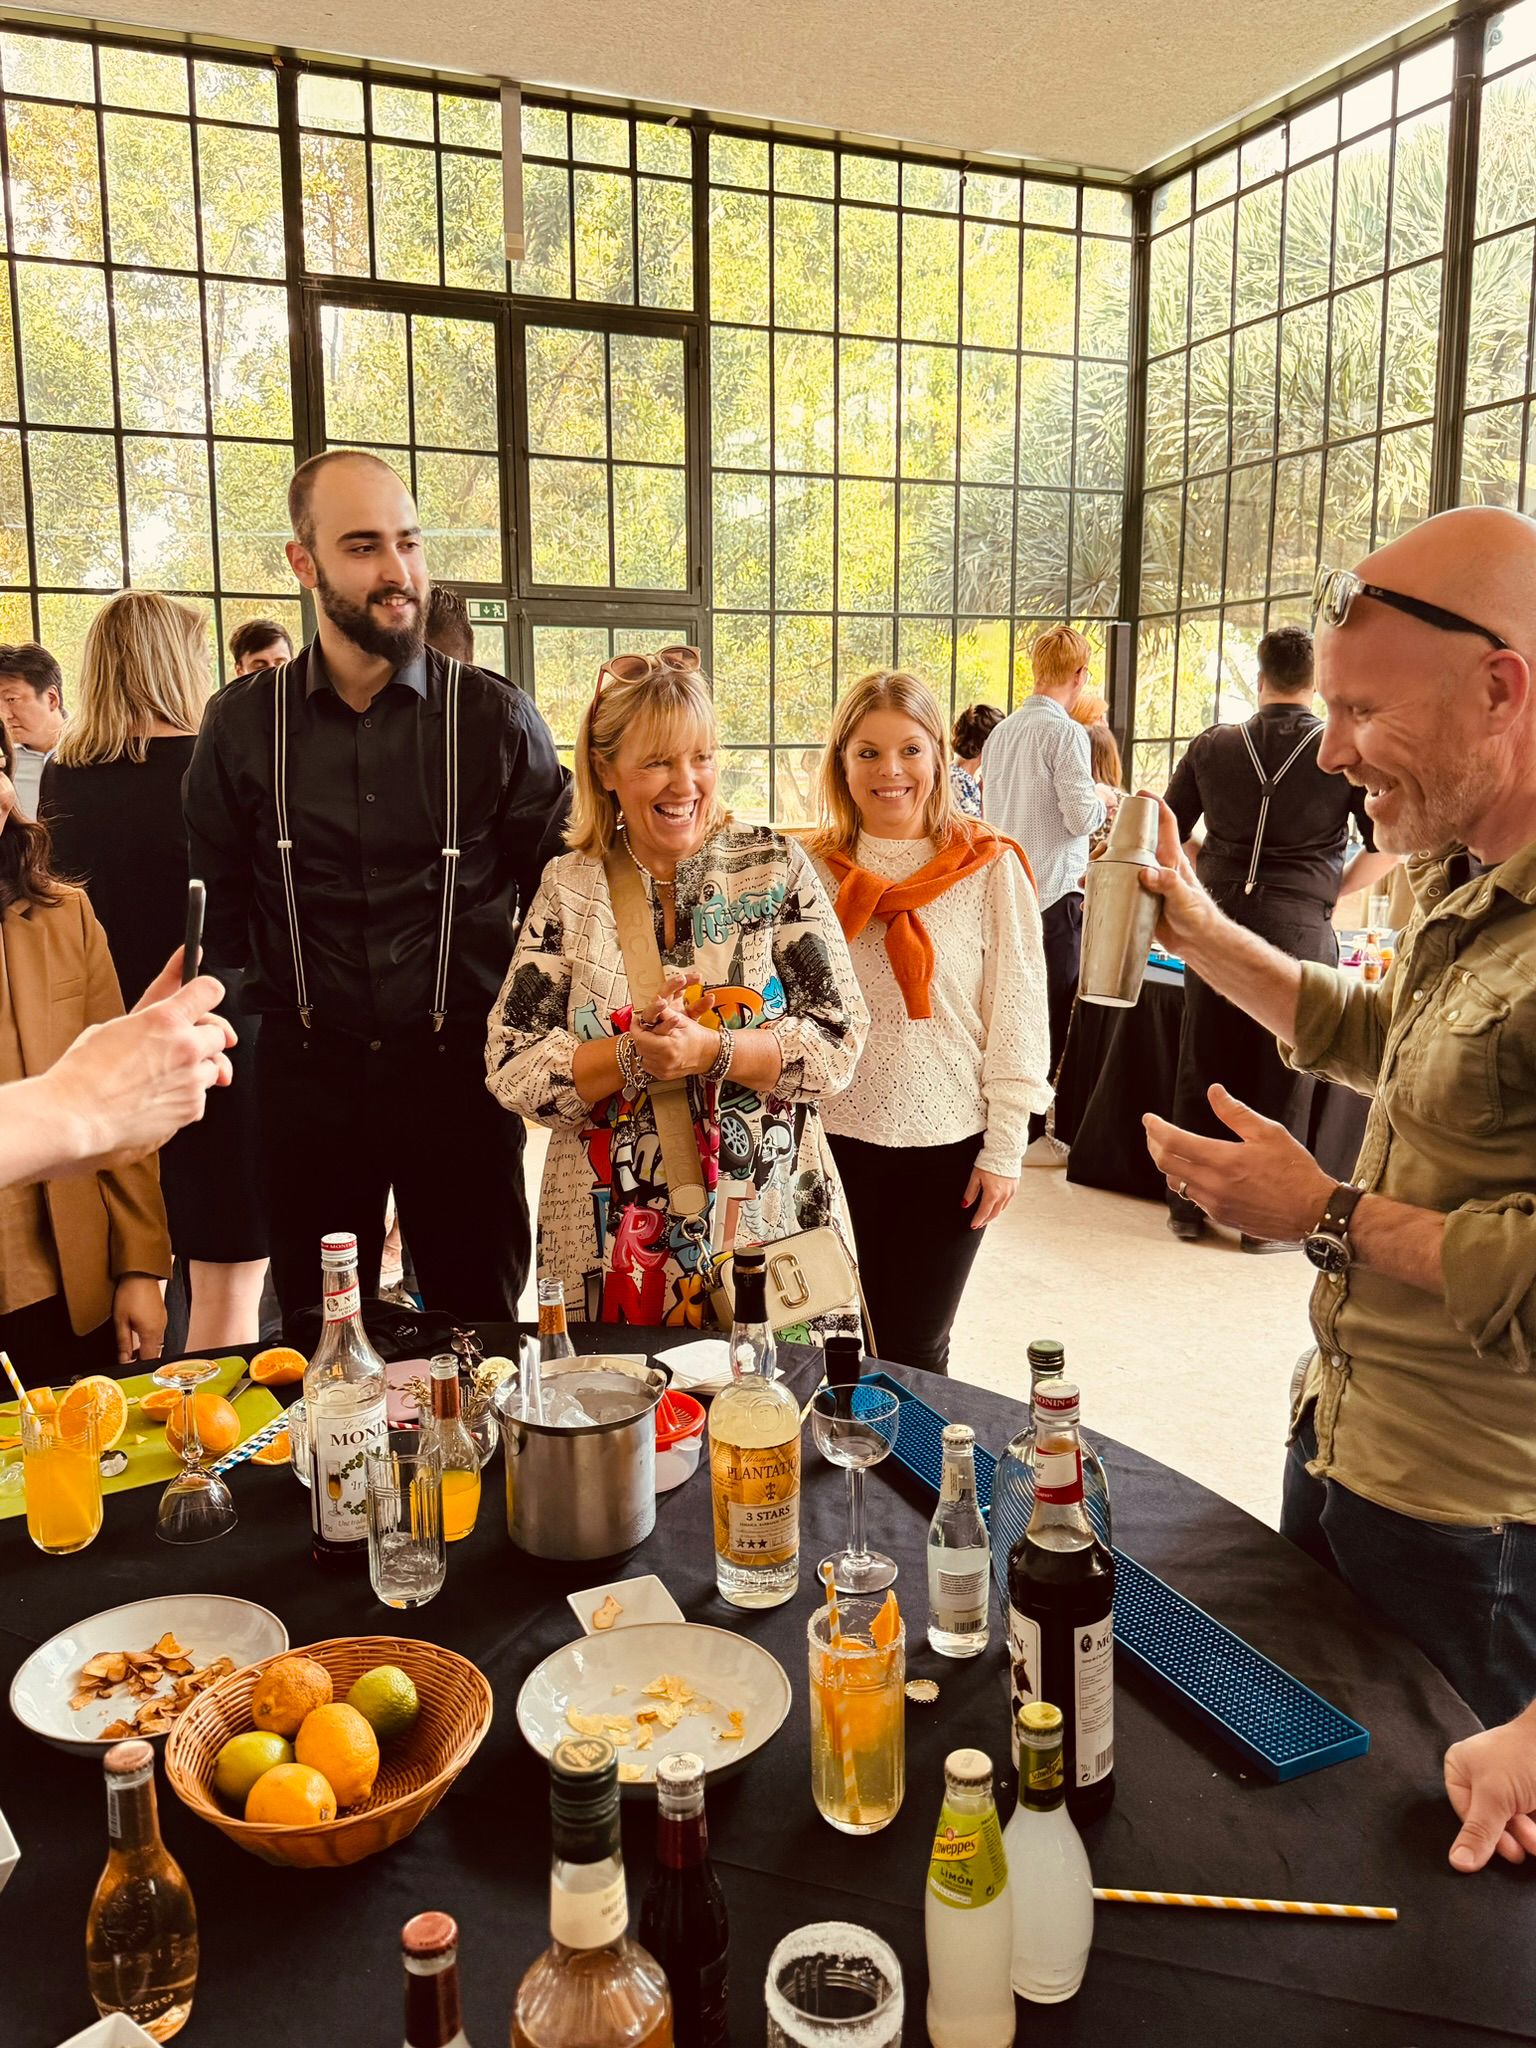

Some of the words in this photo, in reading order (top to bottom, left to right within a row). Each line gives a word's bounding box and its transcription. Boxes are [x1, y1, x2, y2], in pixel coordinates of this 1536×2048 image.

[746, 1512, 753, 1521] 3
[756, 1504, 791, 1522] STARS
[939, 1866, 975, 1887] LIMÓN
